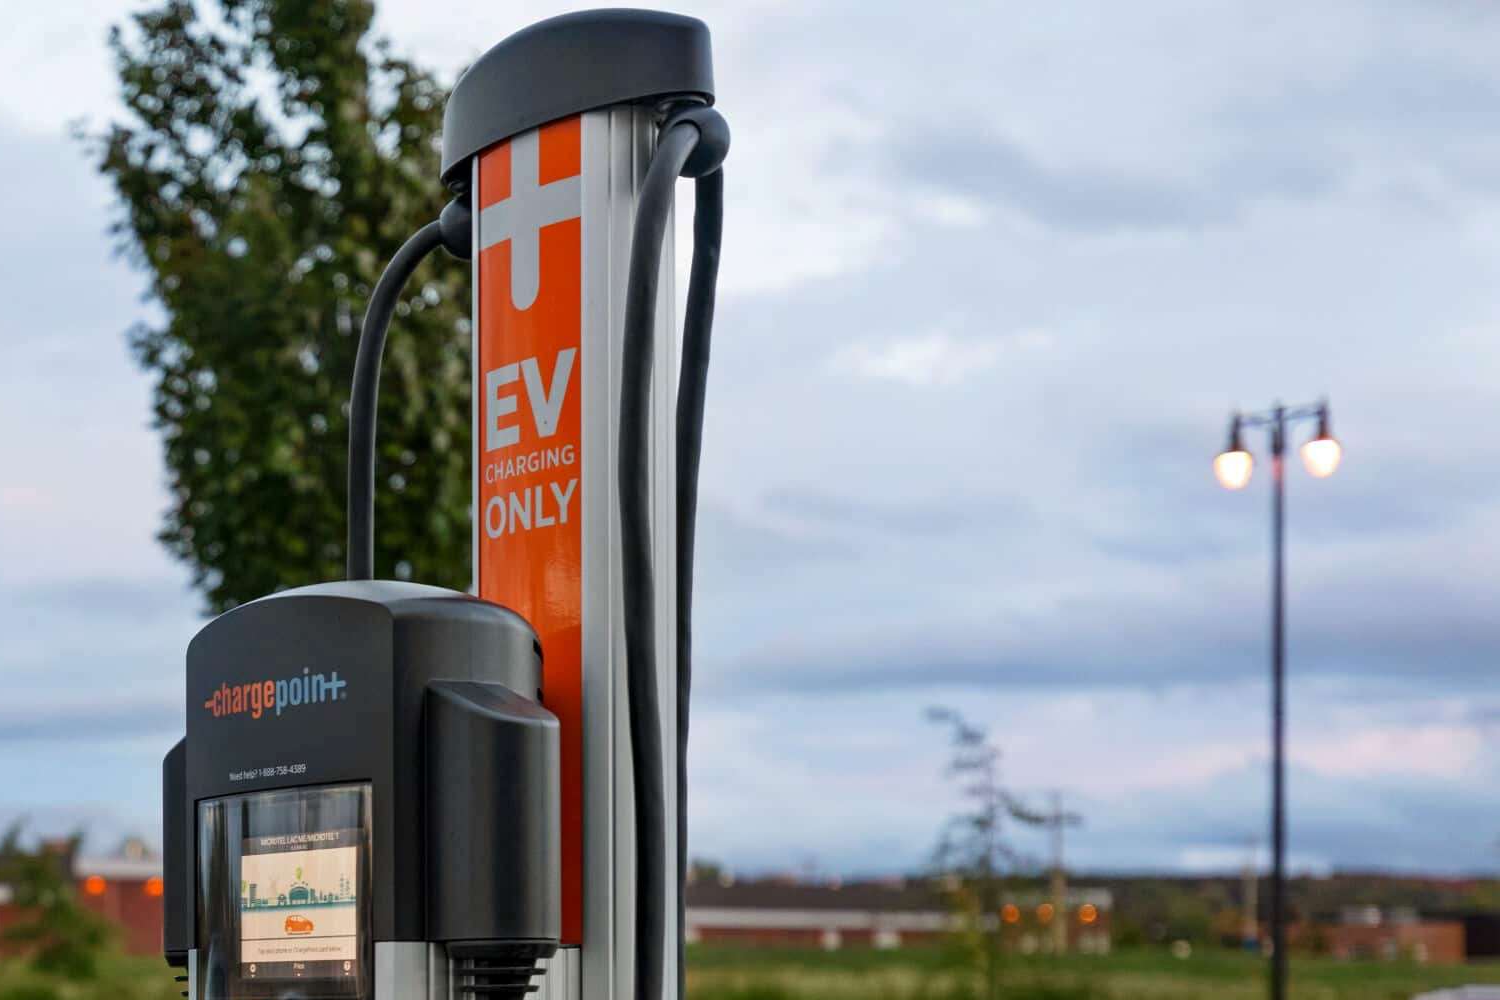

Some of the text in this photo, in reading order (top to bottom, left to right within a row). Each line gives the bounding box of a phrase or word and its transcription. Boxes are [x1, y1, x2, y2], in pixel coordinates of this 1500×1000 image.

[486, 347, 577, 452] EV
[486, 445, 574, 484] CHARGING
[486, 478, 579, 539] ONLY
